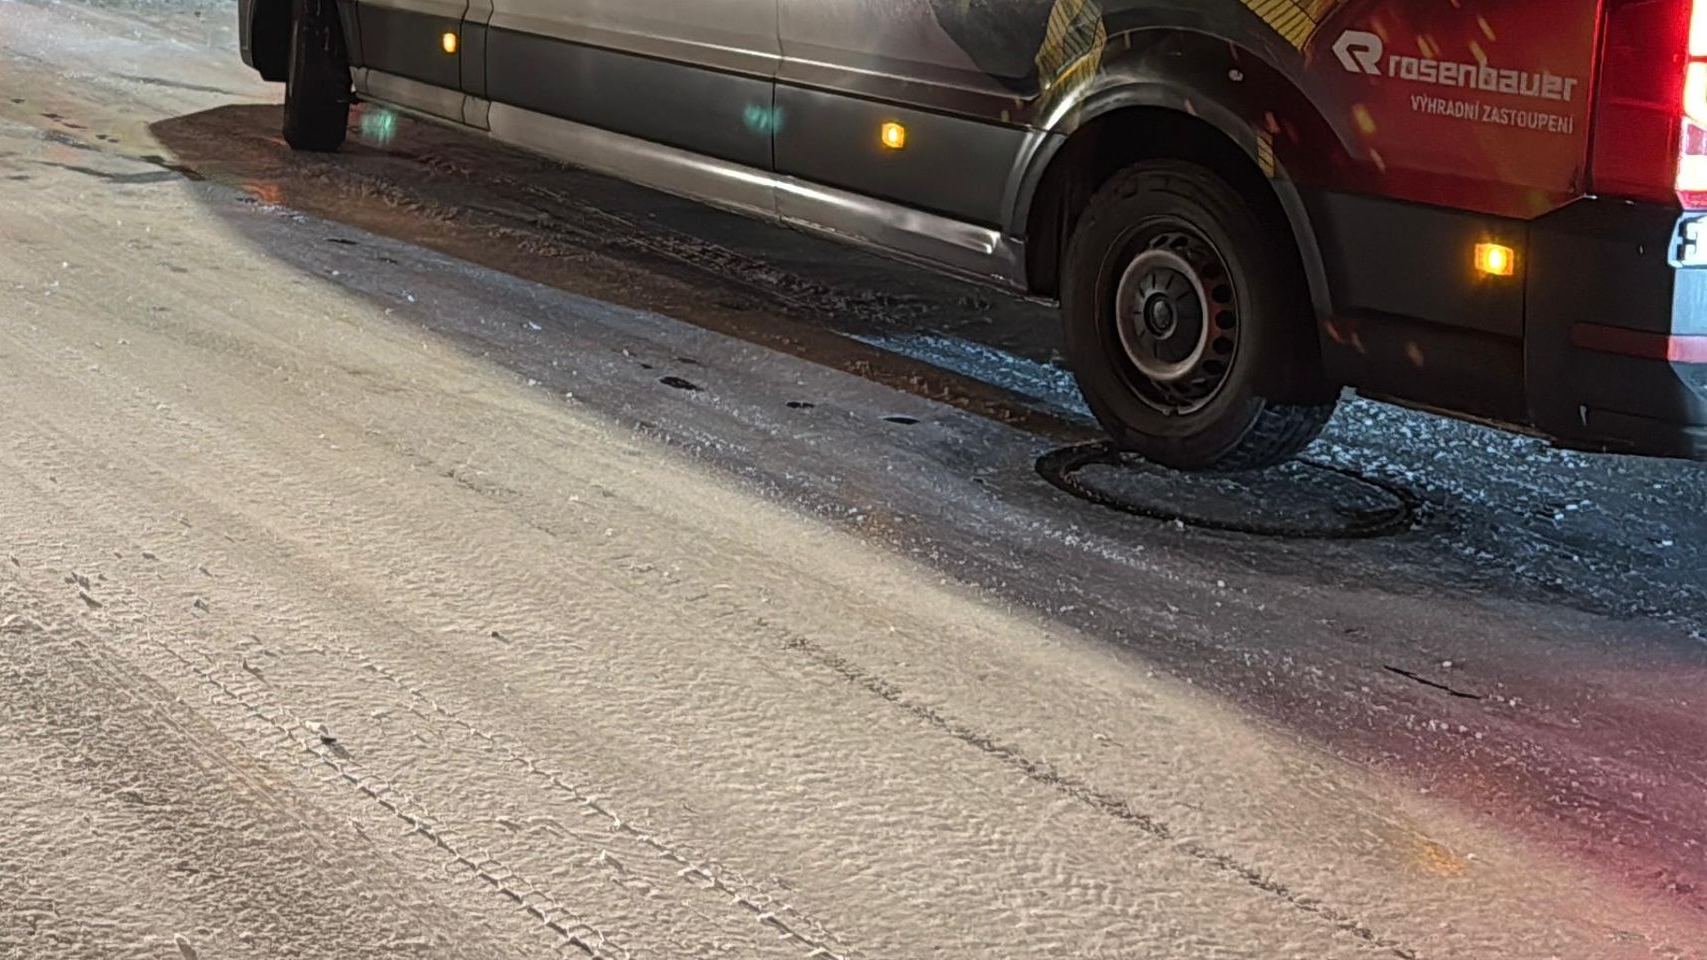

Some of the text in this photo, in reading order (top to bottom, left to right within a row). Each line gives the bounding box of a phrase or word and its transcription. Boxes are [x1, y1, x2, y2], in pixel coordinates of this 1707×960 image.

[1388, 55, 1578, 102] rosenbauer
[1411, 93, 1574, 135] VÝHRADNÍ ZASTOUPENÍ
